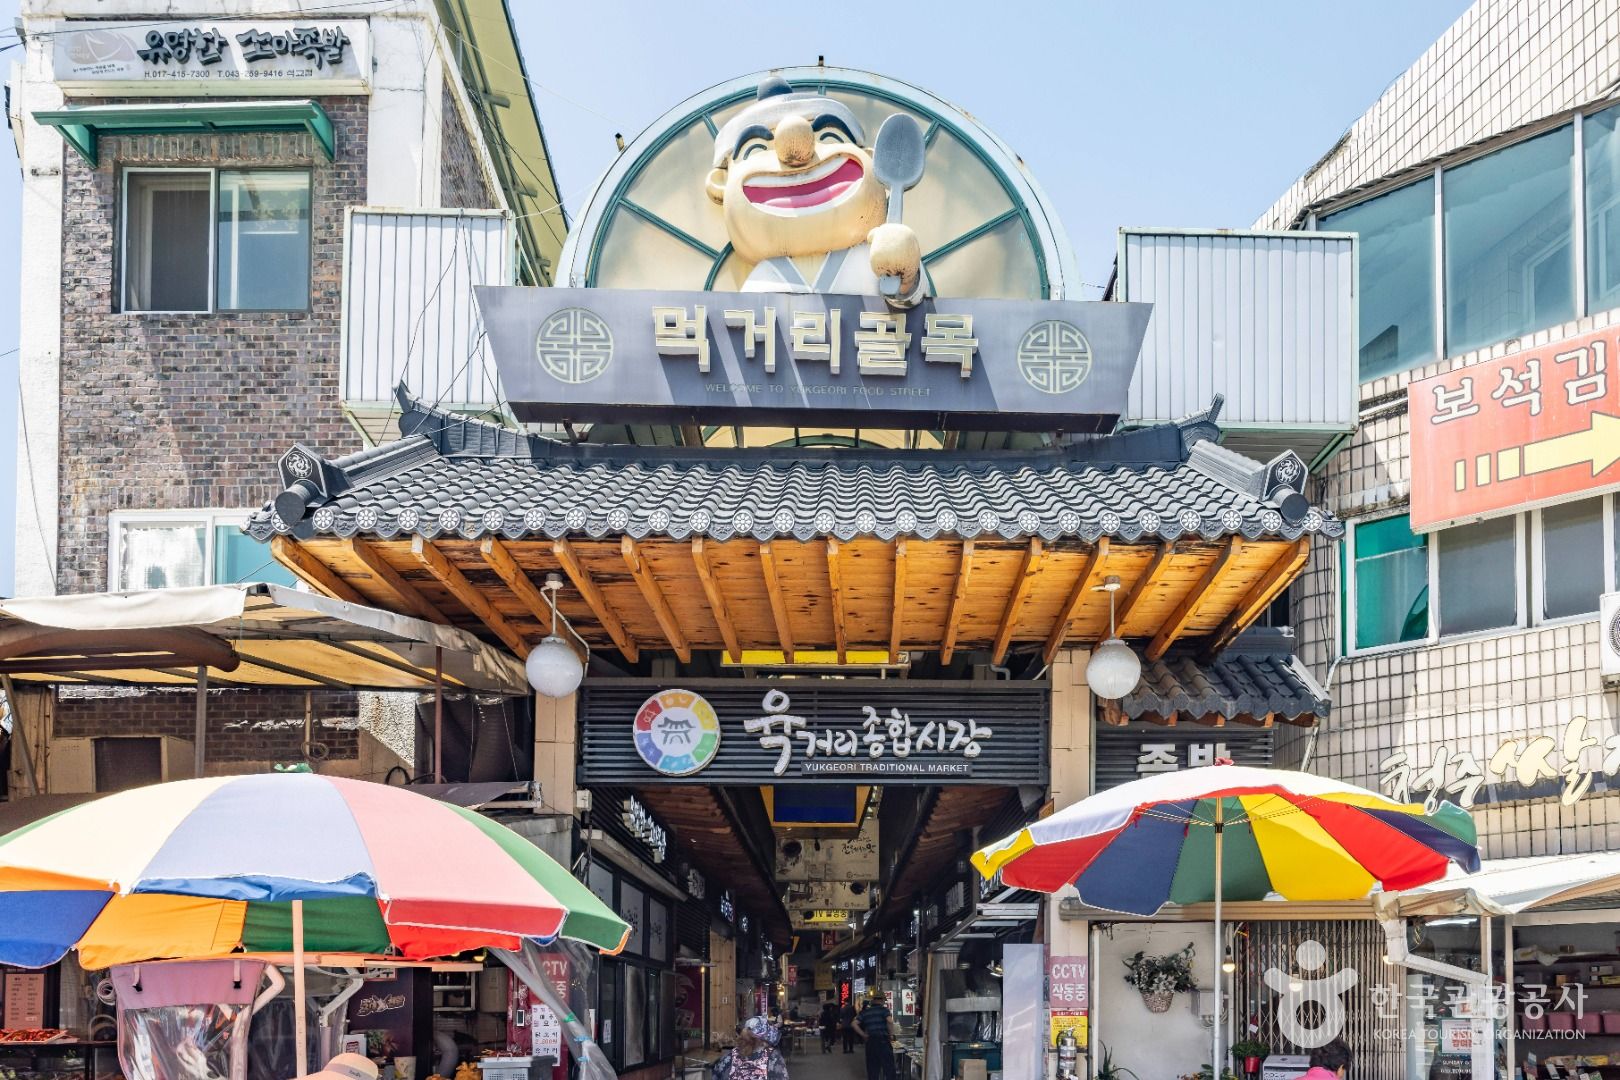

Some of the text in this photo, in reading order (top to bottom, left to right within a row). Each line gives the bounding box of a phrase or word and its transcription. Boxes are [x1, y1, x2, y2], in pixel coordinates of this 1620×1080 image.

[705, 383, 931, 397] WELCOME TO YUKGEORI FOOD STREET
[804, 763, 969, 773] YUKGEORI TRADITIONAL MARKET
[543, 960, 567, 977] CTV
[1051, 963, 1087, 980] CCTV
[1051, 982, 1087, 1001] 작동중
